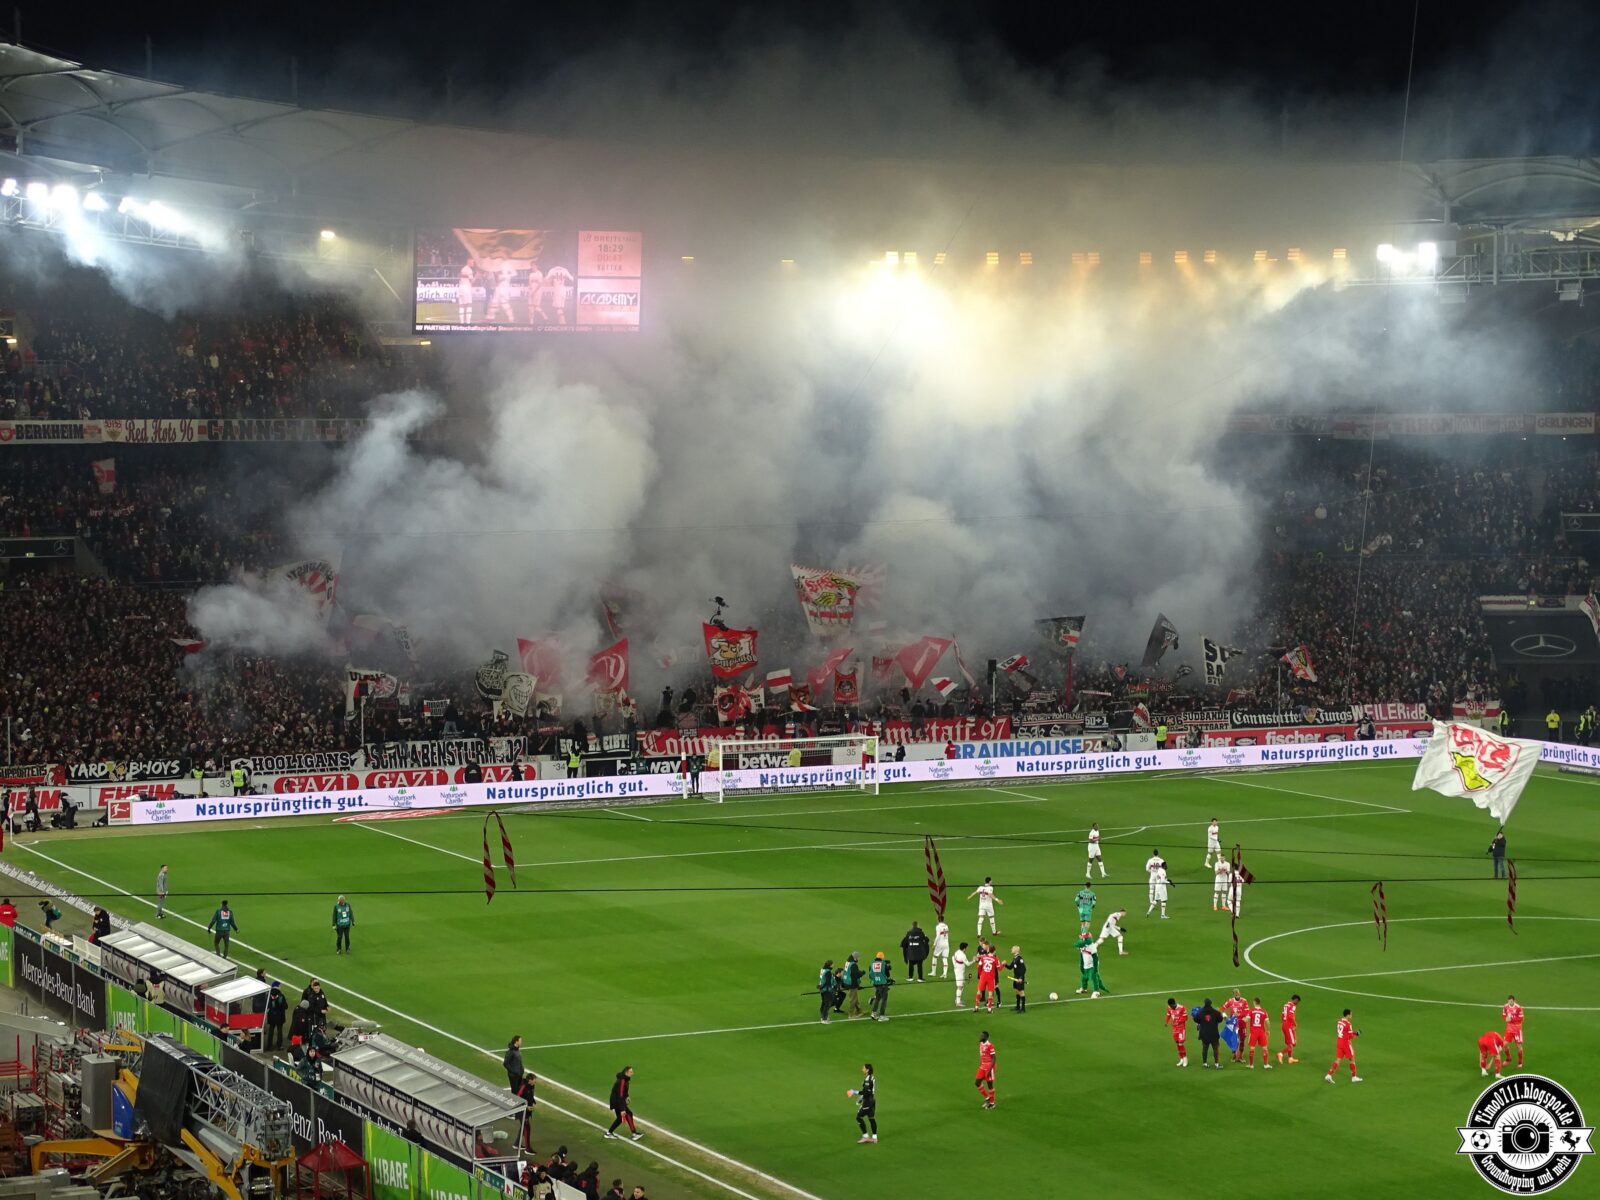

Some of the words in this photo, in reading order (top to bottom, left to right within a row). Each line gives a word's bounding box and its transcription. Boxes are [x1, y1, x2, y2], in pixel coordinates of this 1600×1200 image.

[15, 424, 84, 440] BERKHEIM
[125, 419, 148, 442] Red
[152, 419, 176, 442] Hots
[179, 419, 194, 442] 96
[1314, 707, 1352, 724] Jungs
[981, 717, 1007, 741] 97
[1265, 730, 1321, 746] fischer
[1140, 735, 1149, 743] 36
[1175, 733, 1232, 750] ficher
[956, 738, 1082, 759] BRAINHOUSE
[1084, 740, 1102, 753] 24
[1261, 744, 1368, 761] Natursprünglich
[1373, 744, 1398, 758] gut.
[251, 752, 350, 771] HOOLIGANS
[617, 759, 682, 777] beway
[738, 752, 793, 770] betwa
[1016, 754, 1130, 773] Natursprünglich
[1135, 754, 1162, 770] gut.
[69, 762, 109, 779] YARD
[760, 767, 876, 787] Natursprünglich
[884, 766, 912, 781] gut.
[220, 780, 231, 788] 33
[487, 780, 613, 800] Natursprünglich
[618, 779, 648, 796] gut.
[196, 795, 332, 817] Natursprünglich
[338, 794, 369, 811] gut.
[21, 953, 74, 1005] Mercedes-Benz
[76, 984, 96, 1018] Bank
[1254, 1013, 1260, 1025] 6
[373, 1157, 410, 1191] LIBARE
